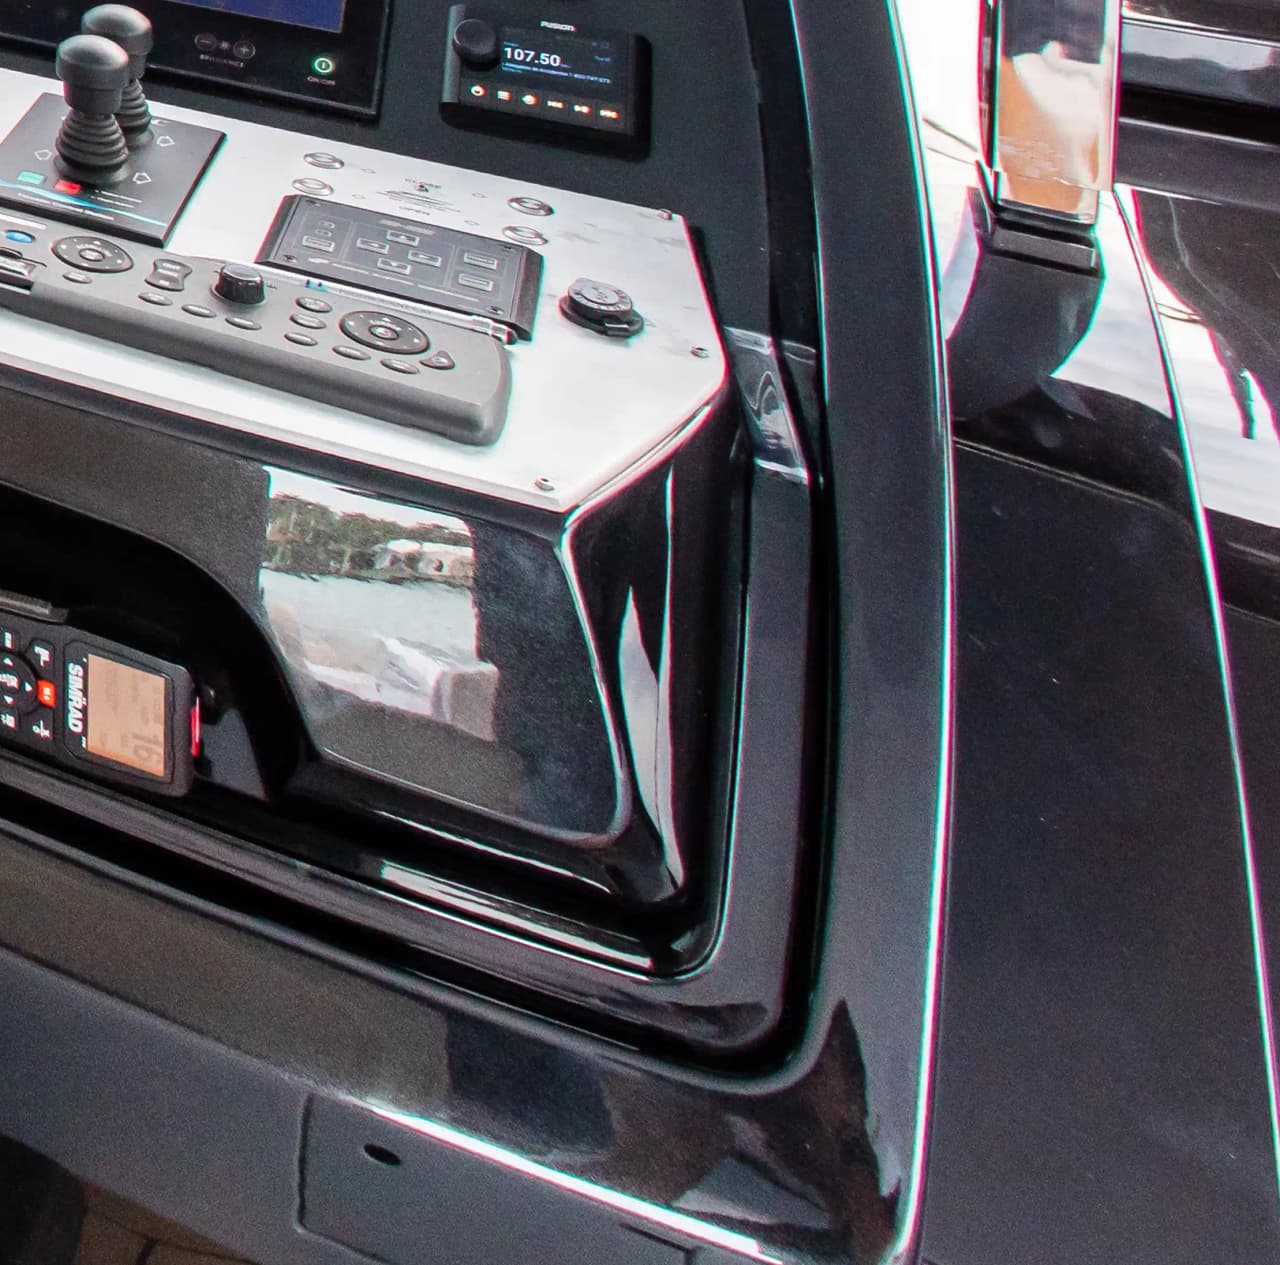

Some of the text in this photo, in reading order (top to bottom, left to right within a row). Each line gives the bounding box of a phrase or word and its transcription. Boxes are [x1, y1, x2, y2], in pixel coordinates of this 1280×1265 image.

[540, 20, 577, 32] FUSION
[504, 47, 562, 67] 107.50
[67, 662, 84, 734] SIMRAD
